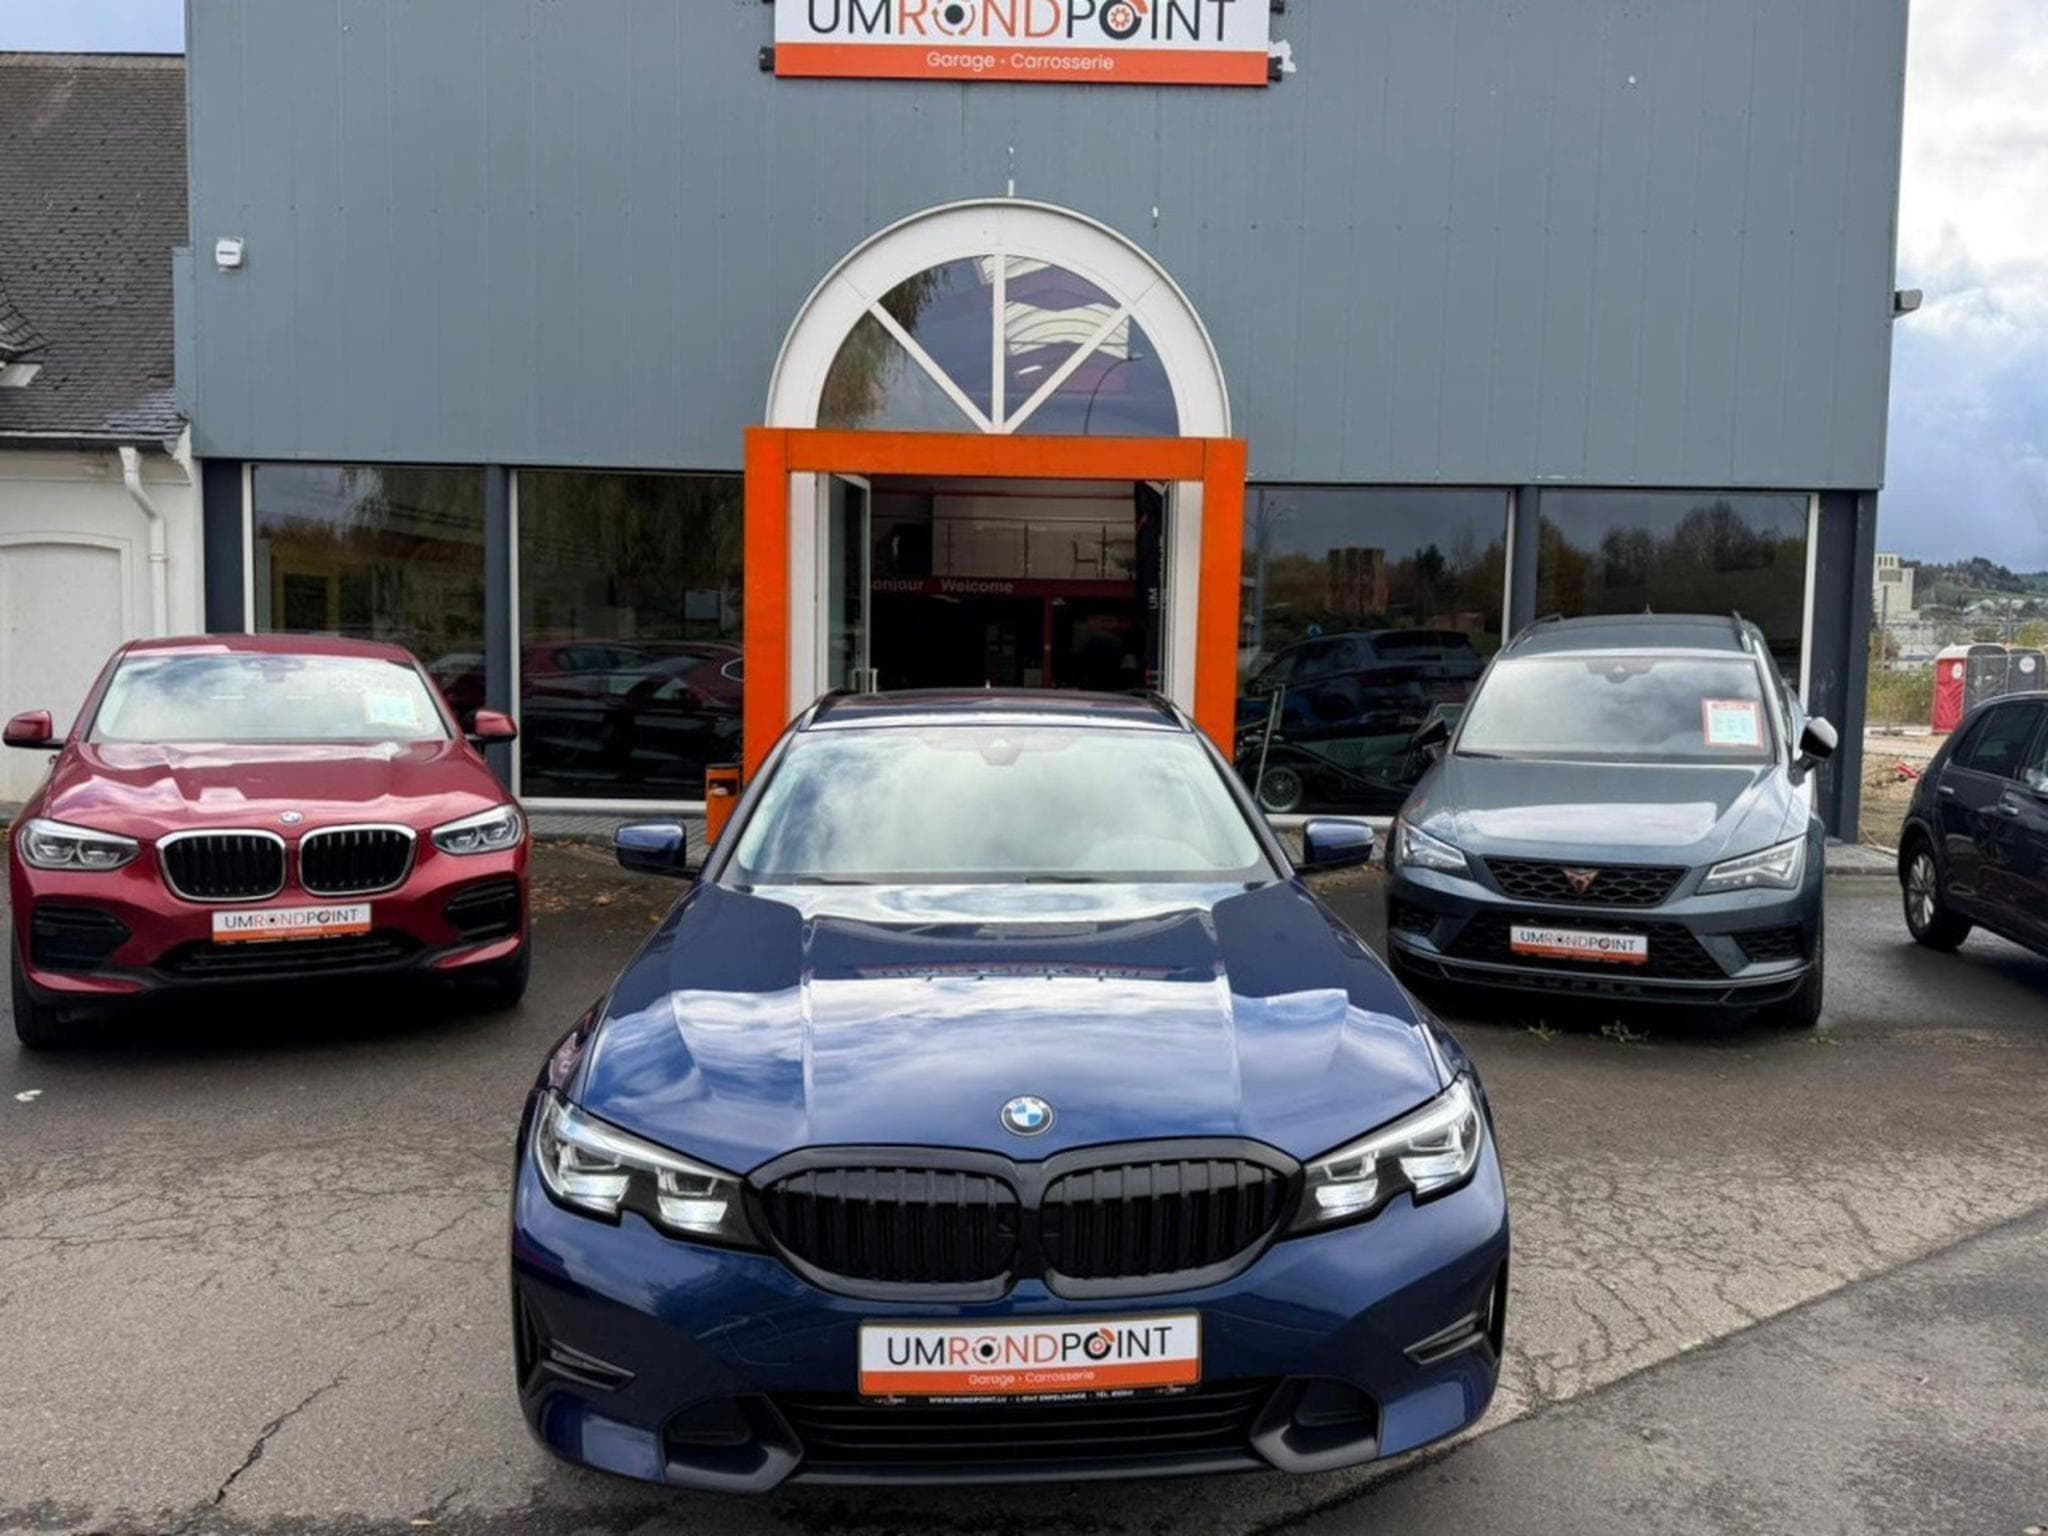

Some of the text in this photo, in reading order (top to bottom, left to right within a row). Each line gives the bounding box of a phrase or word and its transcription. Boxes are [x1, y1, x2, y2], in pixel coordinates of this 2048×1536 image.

[808, 0, 1235, 41] UMRONDPOINT
[927, 51, 1115, 72] Garage Carrosserie
[872, 578, 1014, 593] onjour Welcome
[225, 909, 359, 929] UMRONDPOINT
[1520, 931, 1635, 951] UMRONDPOINT
[887, 1326, 1172, 1366] UMRONDPOINT
[968, 1369, 1095, 1387] Garage Carrosserie
